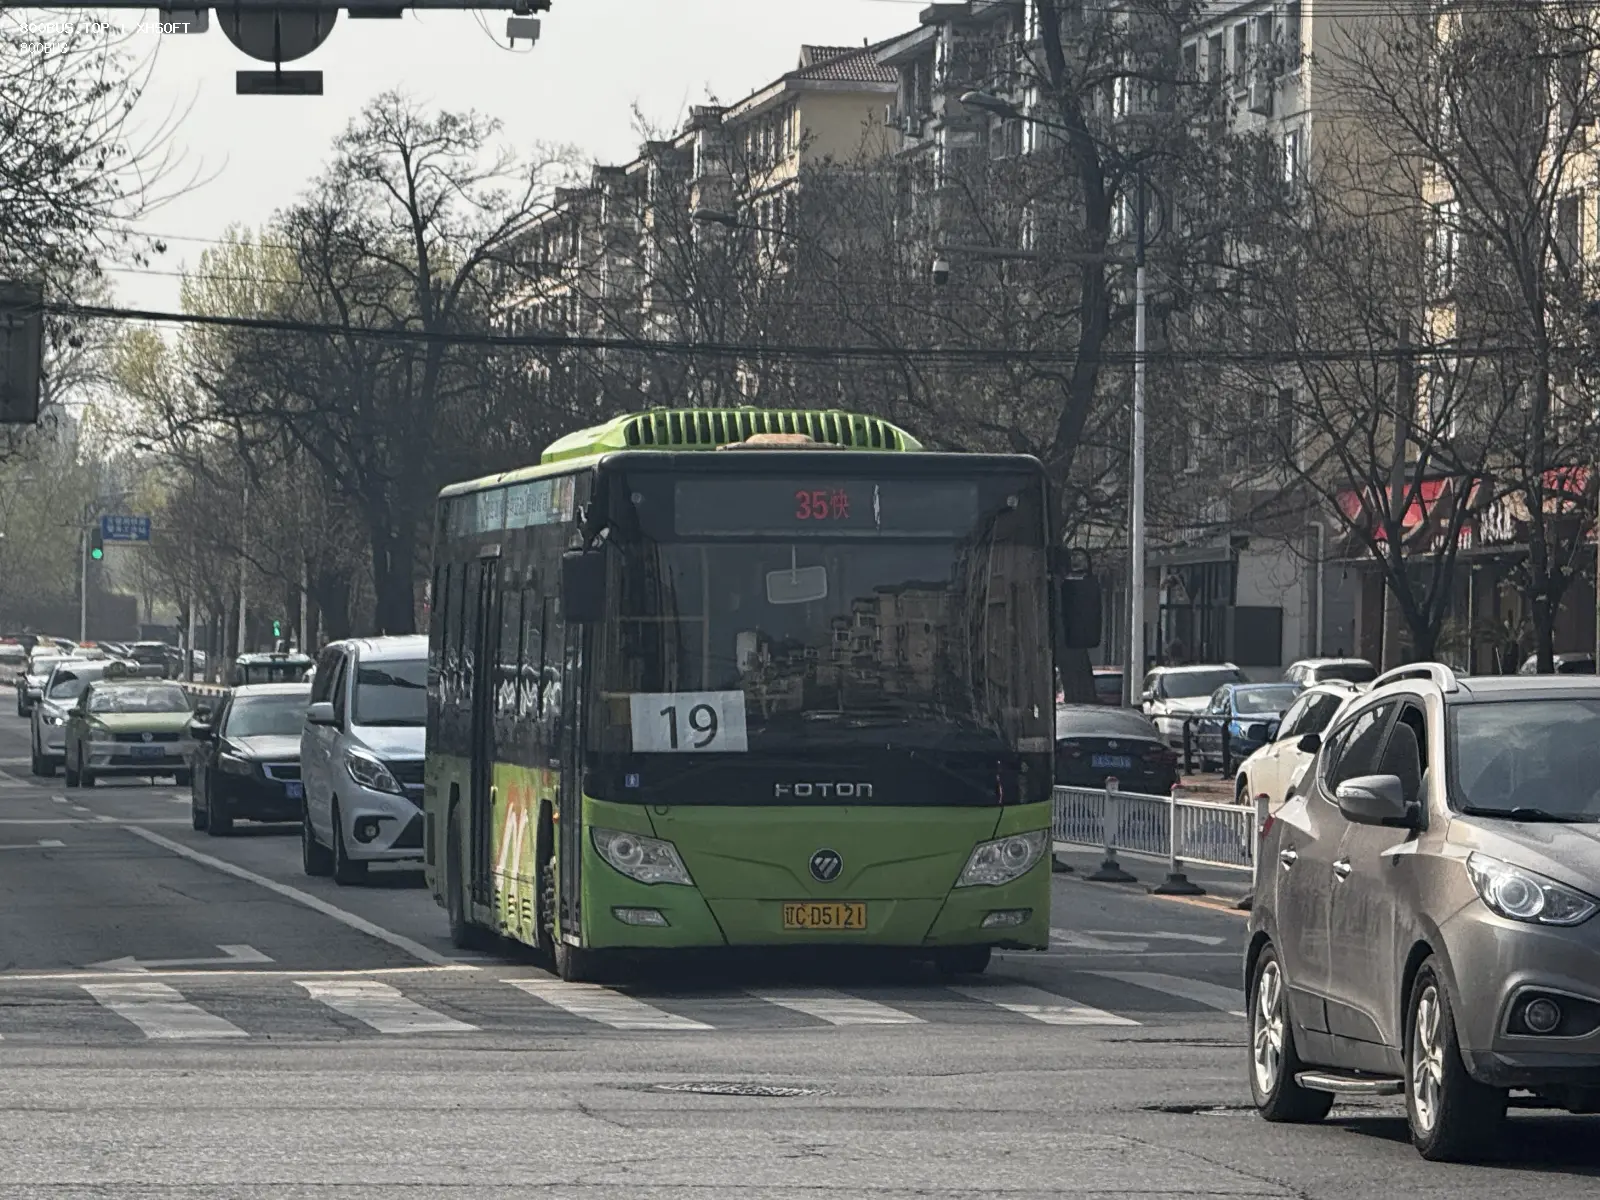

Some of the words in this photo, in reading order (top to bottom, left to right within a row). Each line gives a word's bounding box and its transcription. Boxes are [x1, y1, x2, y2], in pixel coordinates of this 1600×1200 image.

[794, 488, 850, 520] 35快
[660, 703, 718, 749] 19
[775, 782, 873, 798] FOTON
